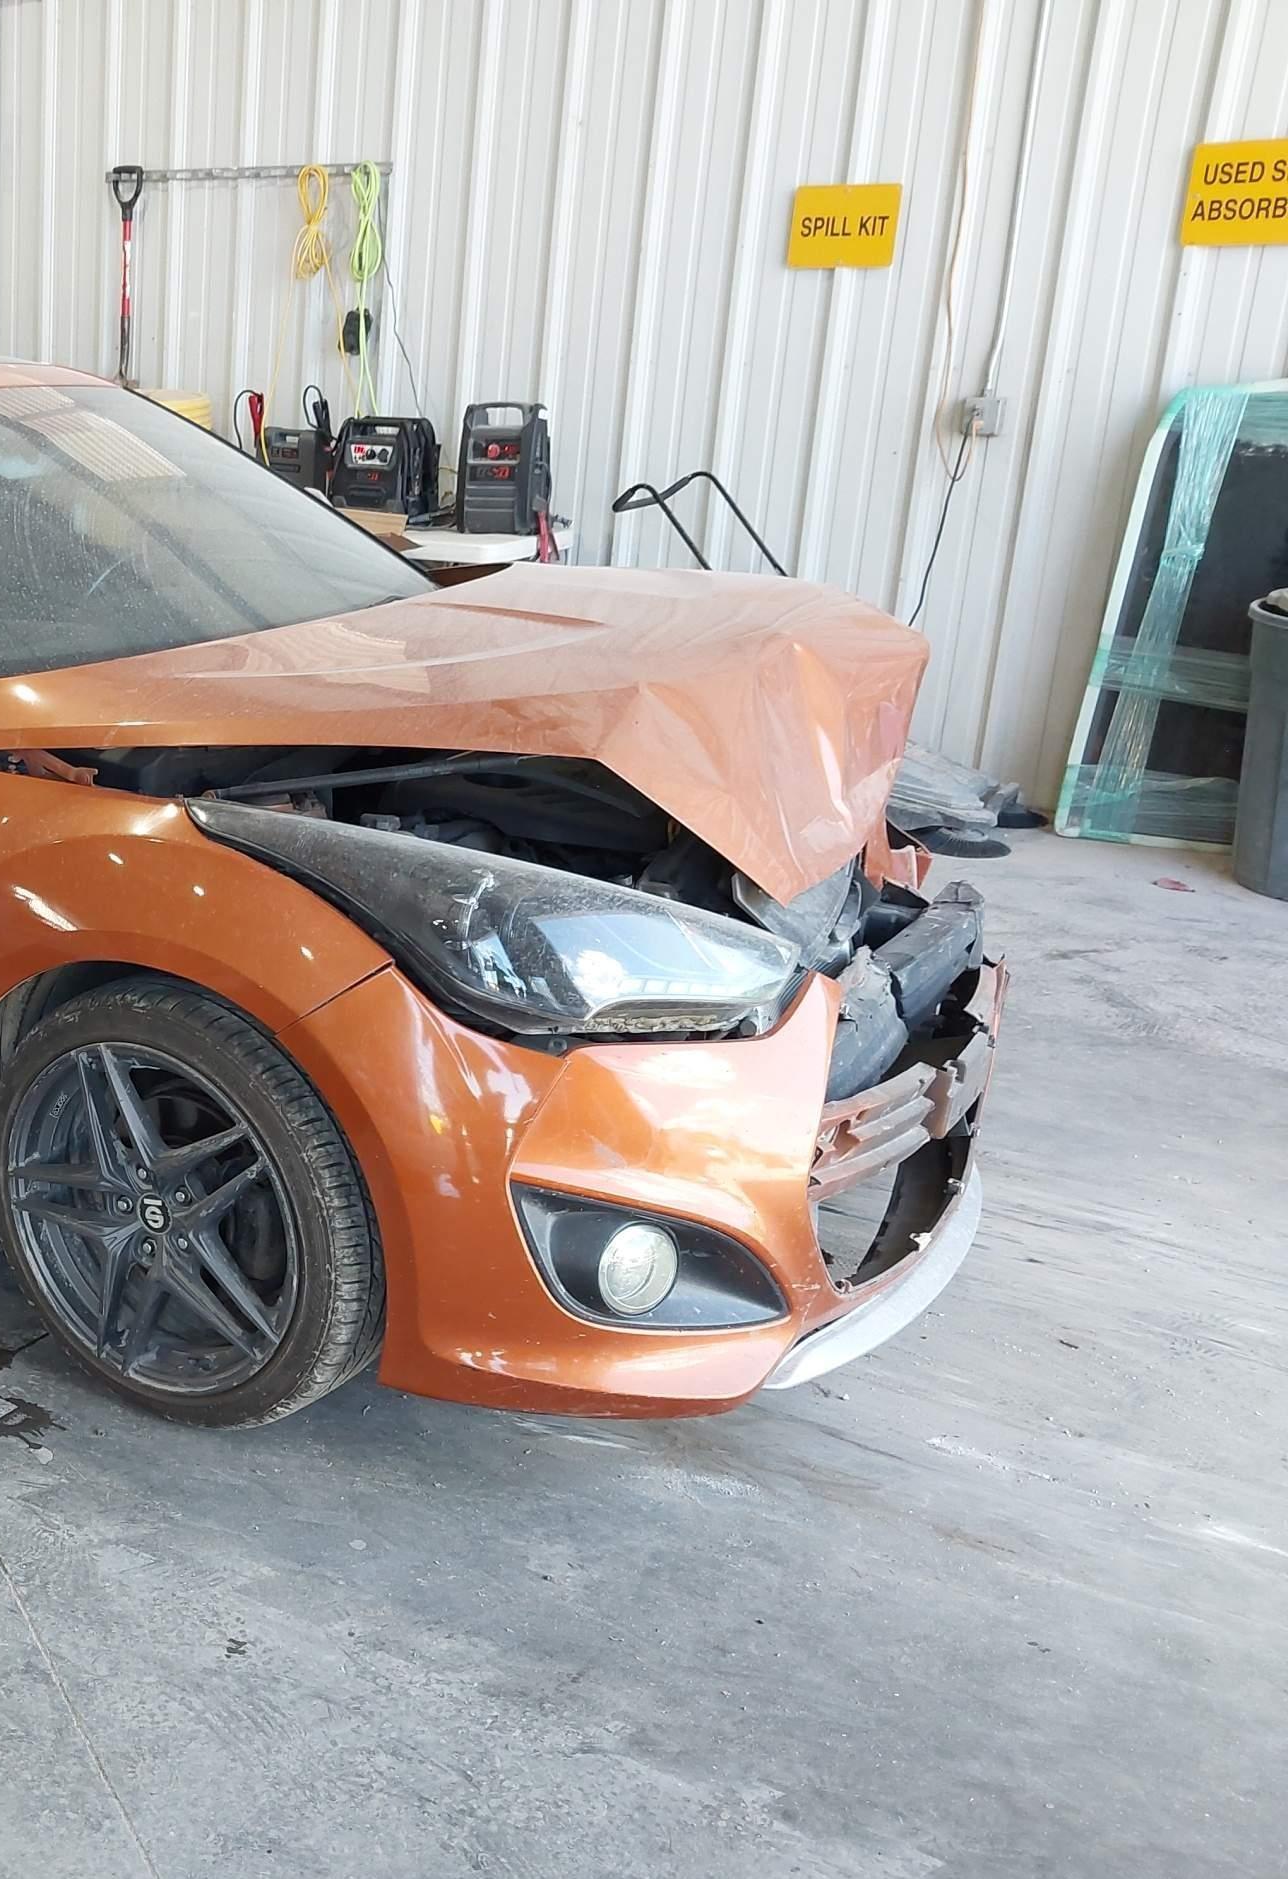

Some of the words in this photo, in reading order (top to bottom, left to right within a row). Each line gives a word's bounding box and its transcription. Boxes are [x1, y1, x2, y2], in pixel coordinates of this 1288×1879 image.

[1203, 160, 1265, 185] USED
[1272, 159, 1288, 182] S
[1190, 196, 1288, 222] ABSORB
[800, 216, 852, 238] SPILL
[858, 215, 890, 237] KIT
